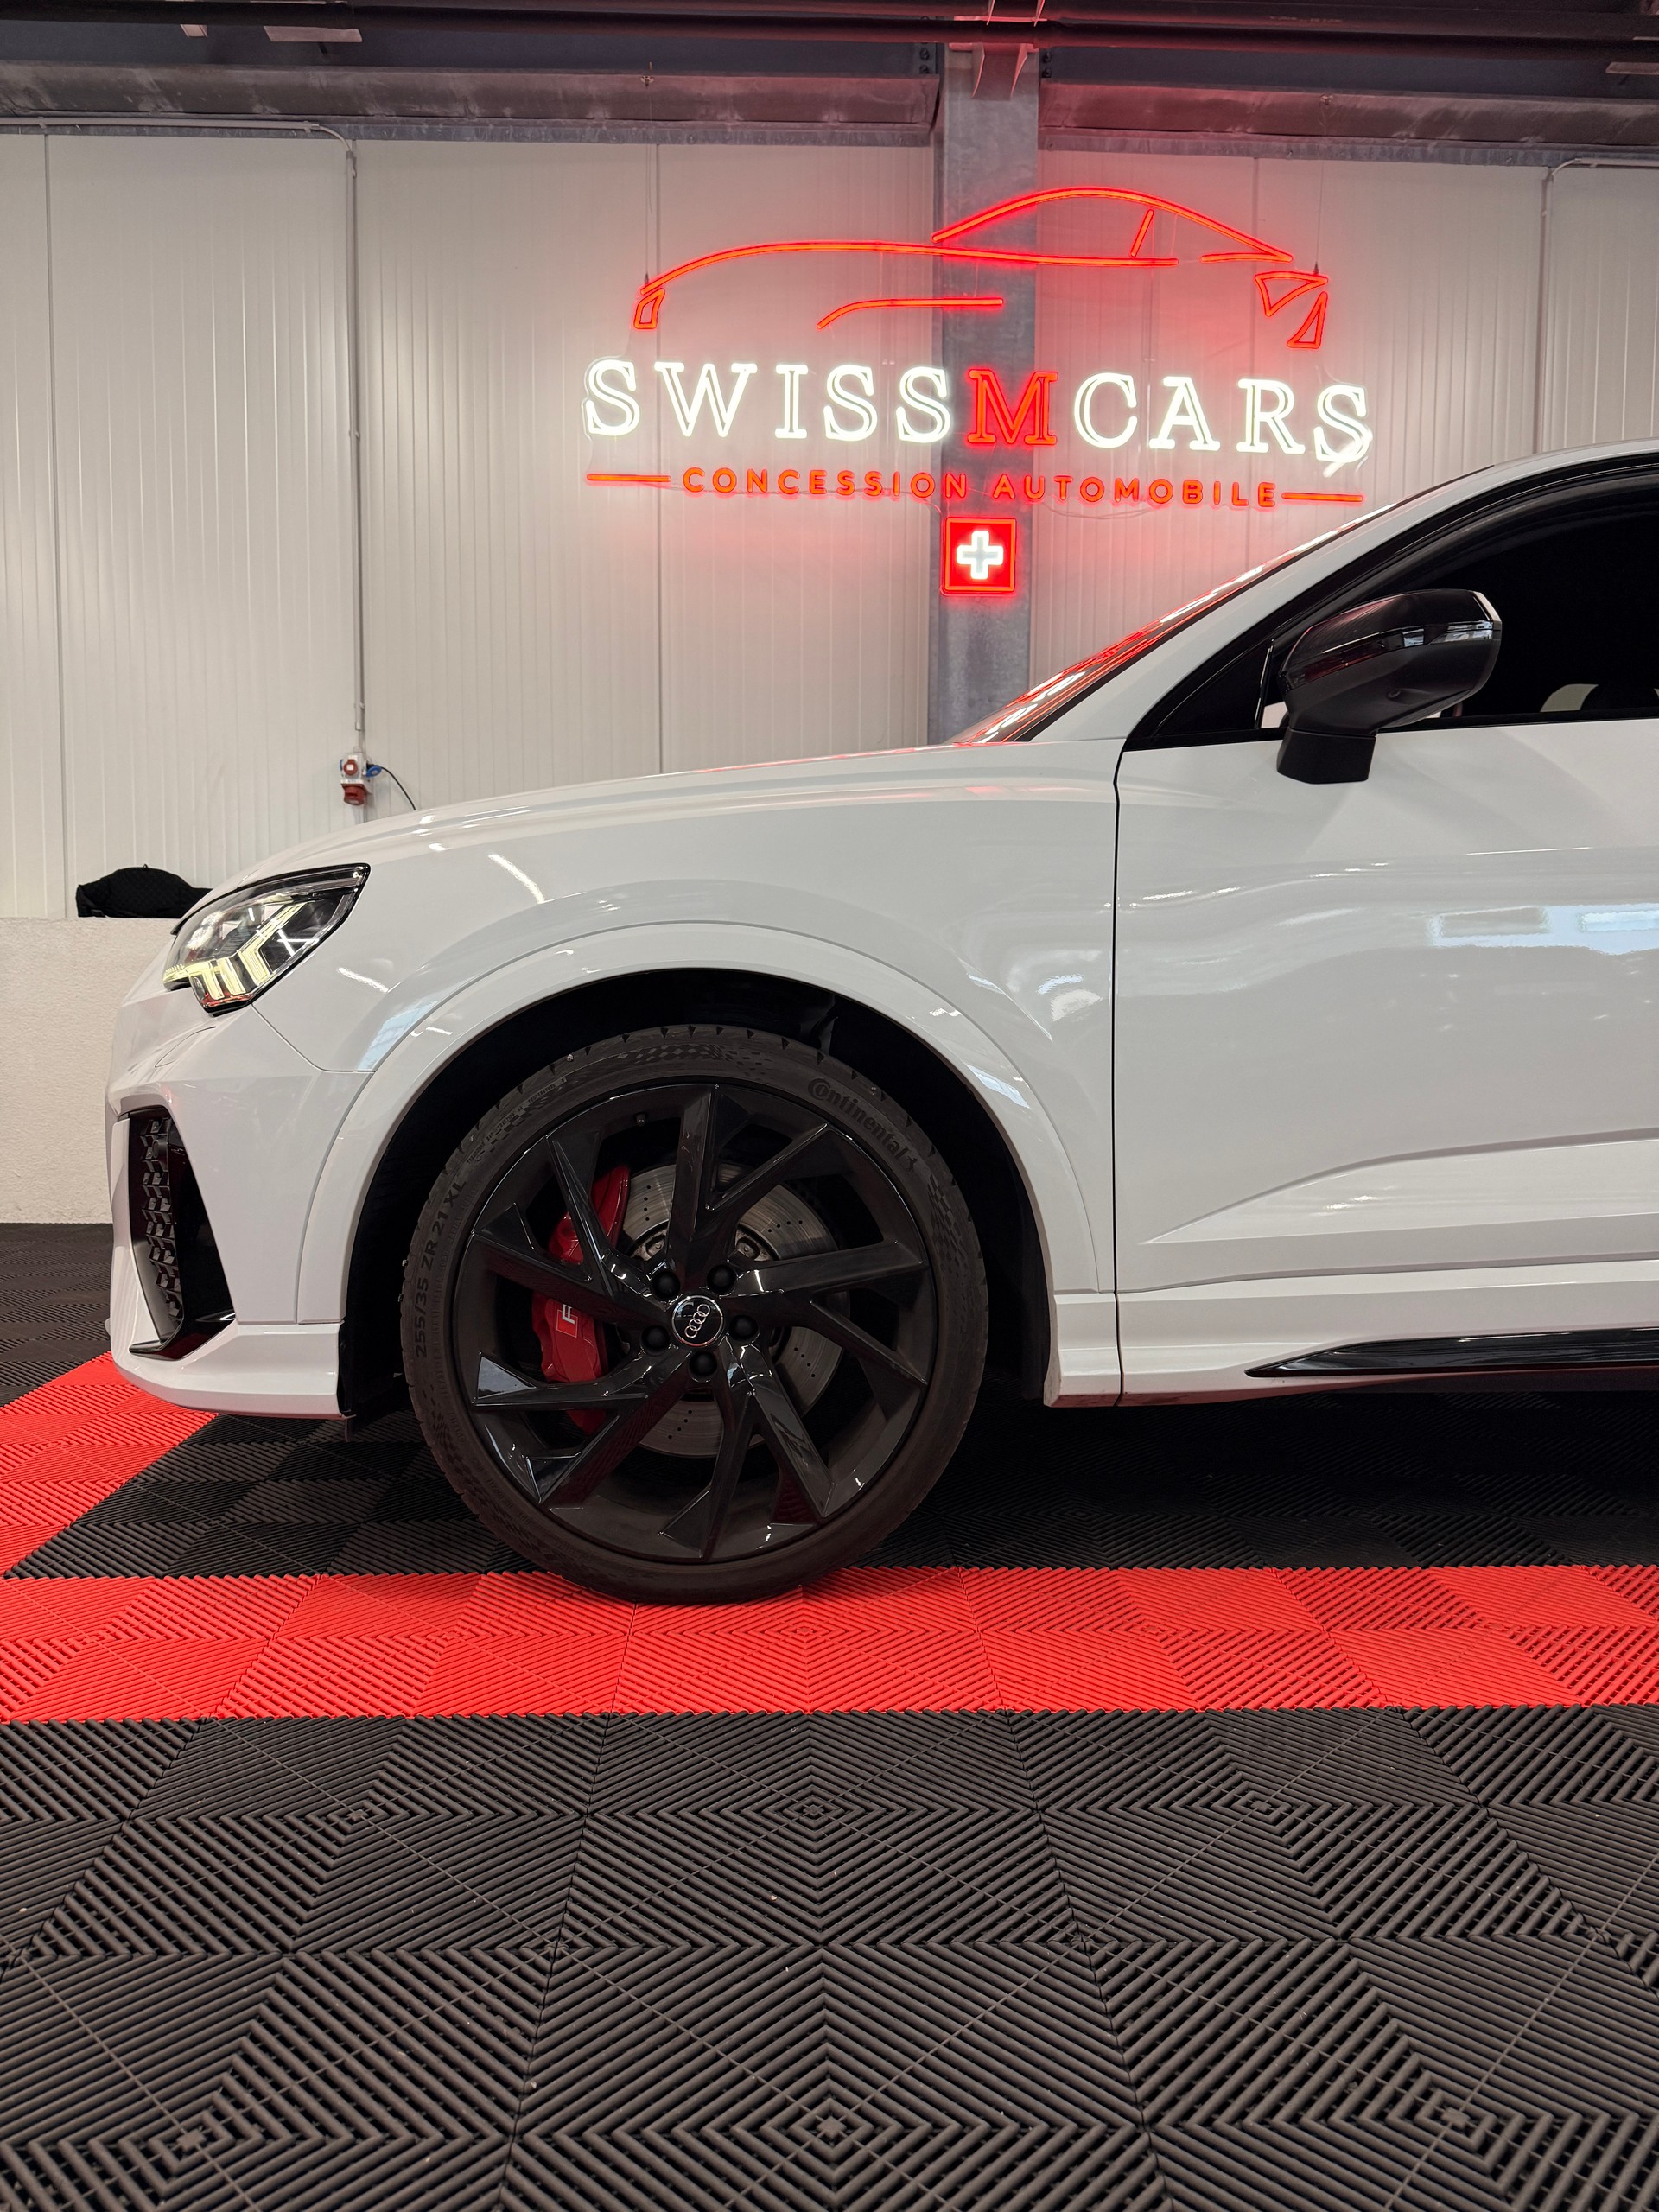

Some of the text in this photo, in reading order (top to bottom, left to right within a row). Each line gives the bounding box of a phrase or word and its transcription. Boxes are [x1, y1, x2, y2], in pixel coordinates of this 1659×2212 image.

[683, 467, 1277, 507] CONCESSION AUTOMOBILE
[808, 1077, 909, 1159] Continental
[414, 1180, 466, 1357] 255/35 ZR 21 XL
